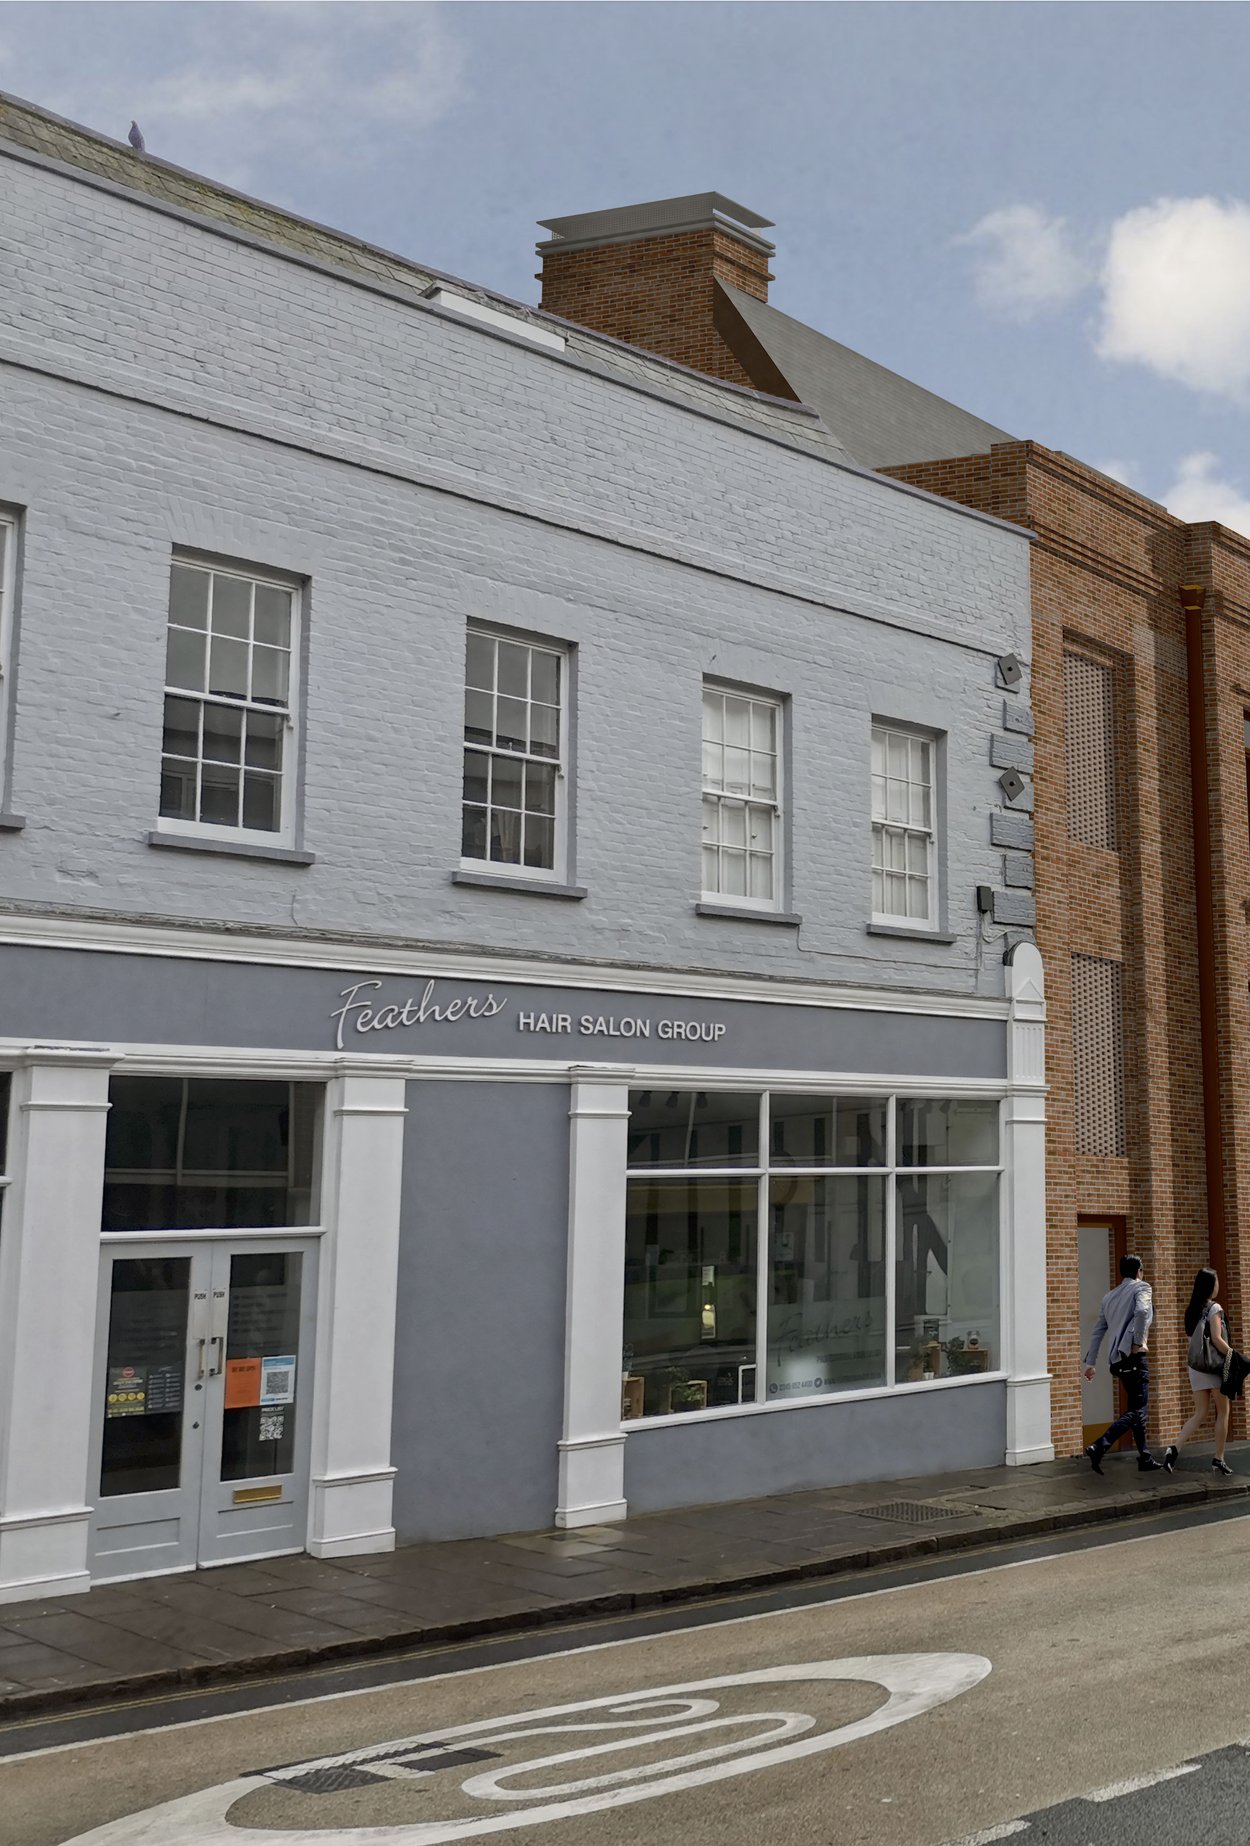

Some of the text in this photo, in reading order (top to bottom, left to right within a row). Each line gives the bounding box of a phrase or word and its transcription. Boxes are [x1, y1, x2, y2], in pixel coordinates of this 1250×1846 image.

[330, 979, 727, 1050] Feathers HAIR SALON GROUP
